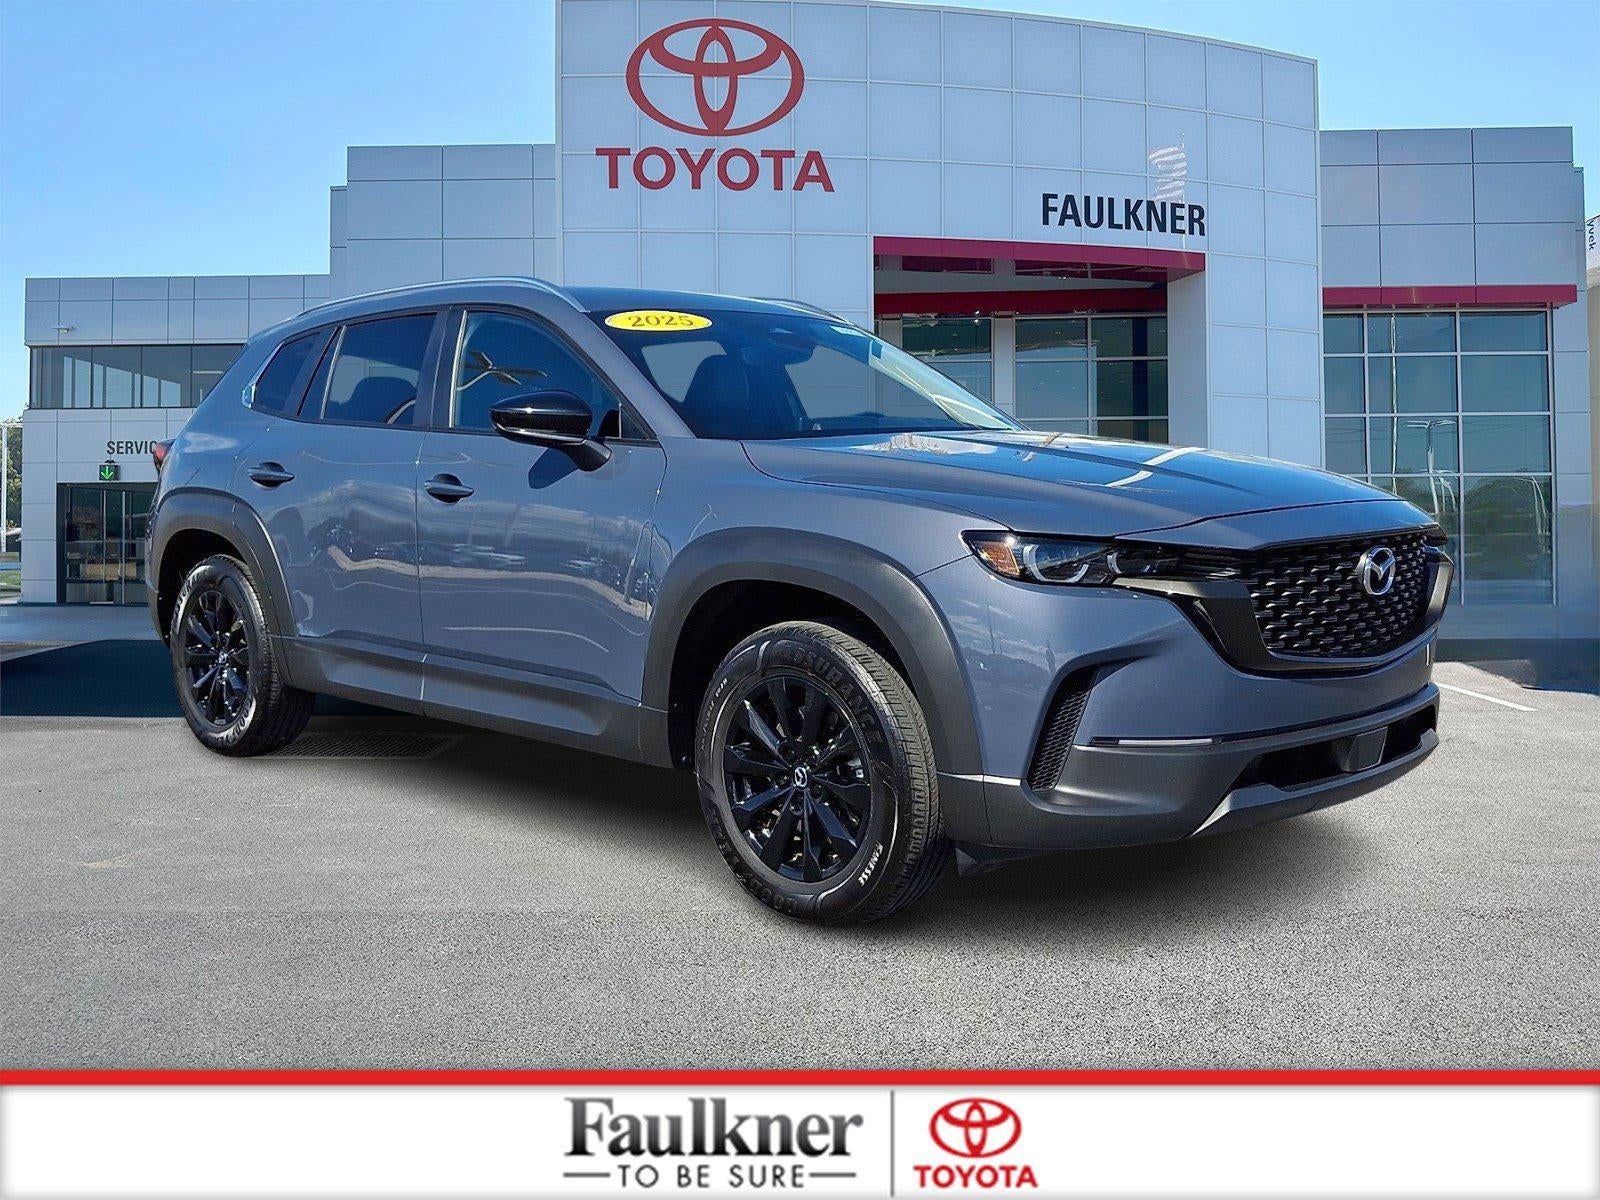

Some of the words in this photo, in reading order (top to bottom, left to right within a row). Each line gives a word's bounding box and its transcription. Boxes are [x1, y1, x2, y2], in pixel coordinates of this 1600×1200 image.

[595, 146, 836, 193] TOYOTA
[1042, 193, 1206, 237] FAULKNER
[628, 315, 694, 327] 2025
